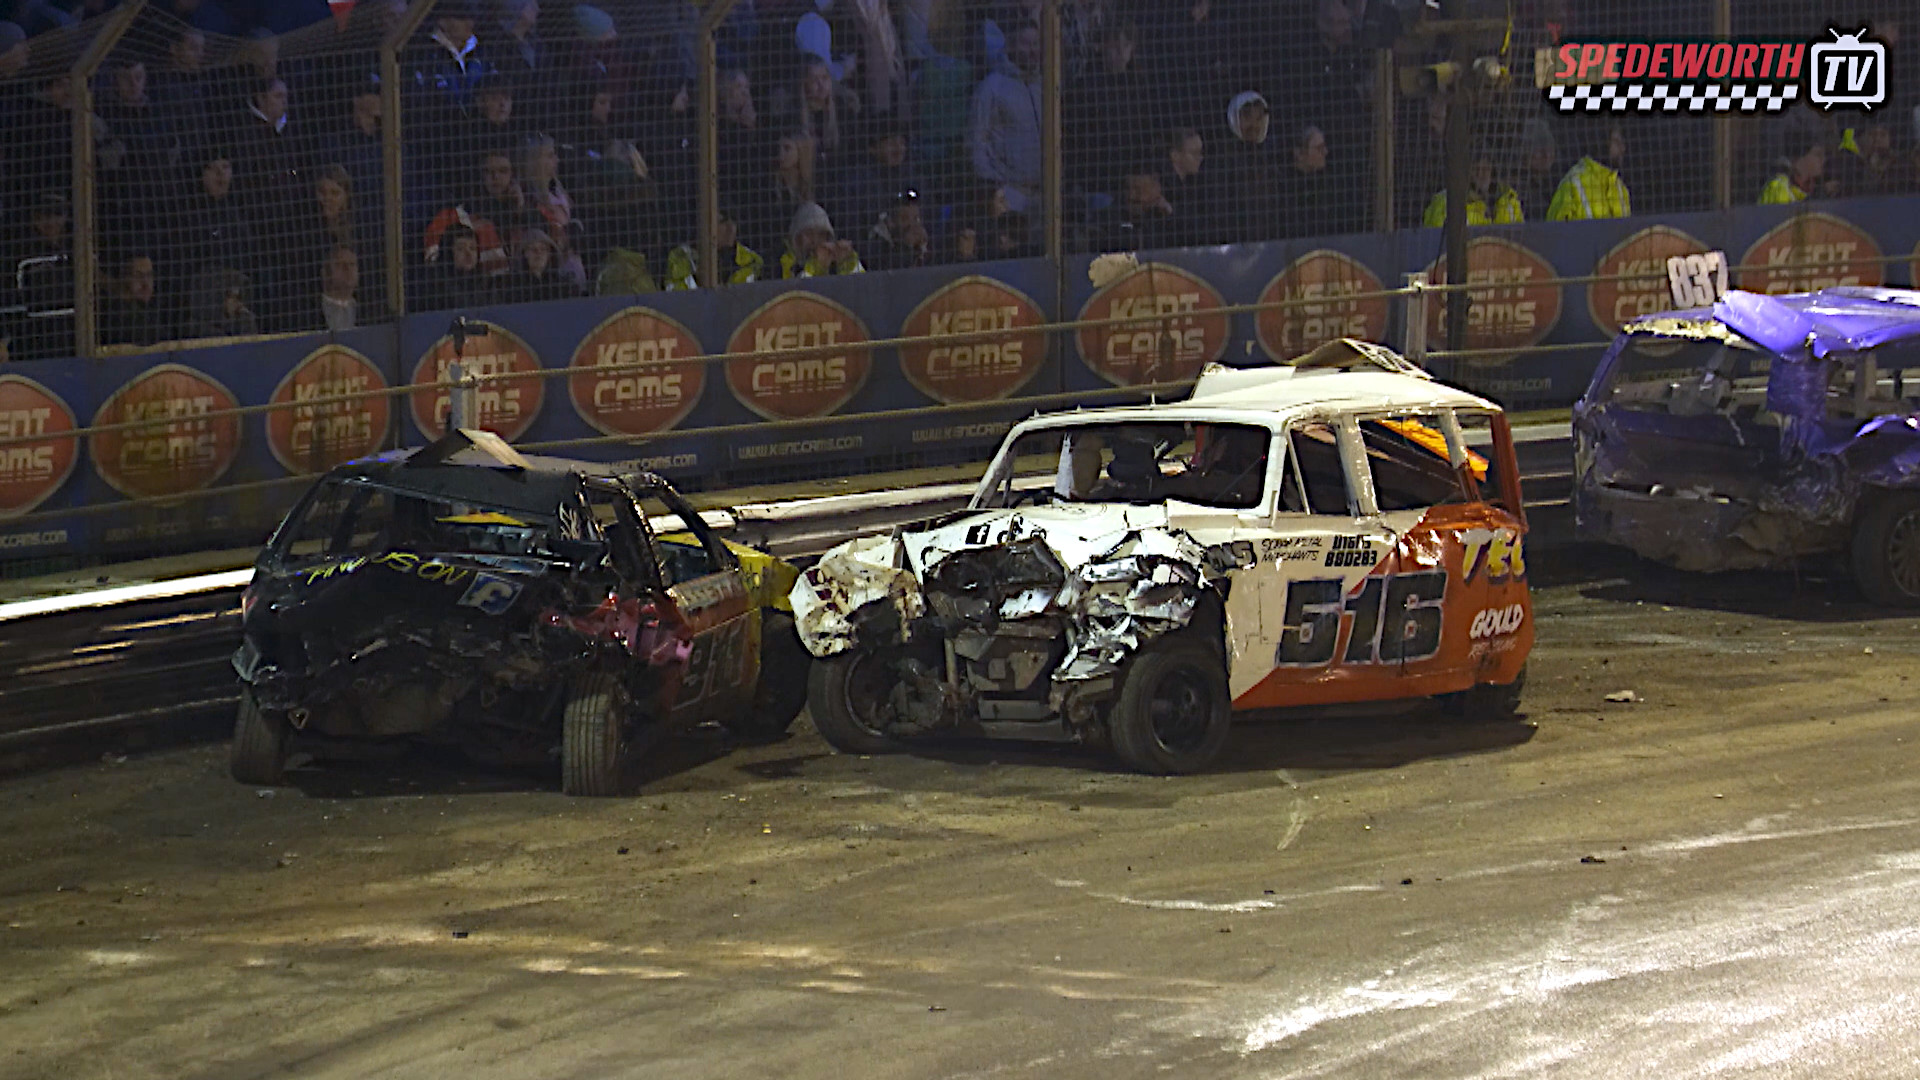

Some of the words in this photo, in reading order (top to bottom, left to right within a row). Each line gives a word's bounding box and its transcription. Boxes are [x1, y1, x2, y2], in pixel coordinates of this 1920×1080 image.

[1667, 250, 1729, 308] 837
[929, 305, 1019, 340] KENT
[1109, 292, 1200, 330] KENT
[597, 337, 679, 376] KENT
[754, 321, 843, 360] KENT
[751, 357, 846, 398] CAMS
[926, 341, 1024, 380] CAMS
[594, 374, 683, 414] CAMS
[1276, 571, 1448, 667] 516
[1469, 603, 1525, 640] GOULD
